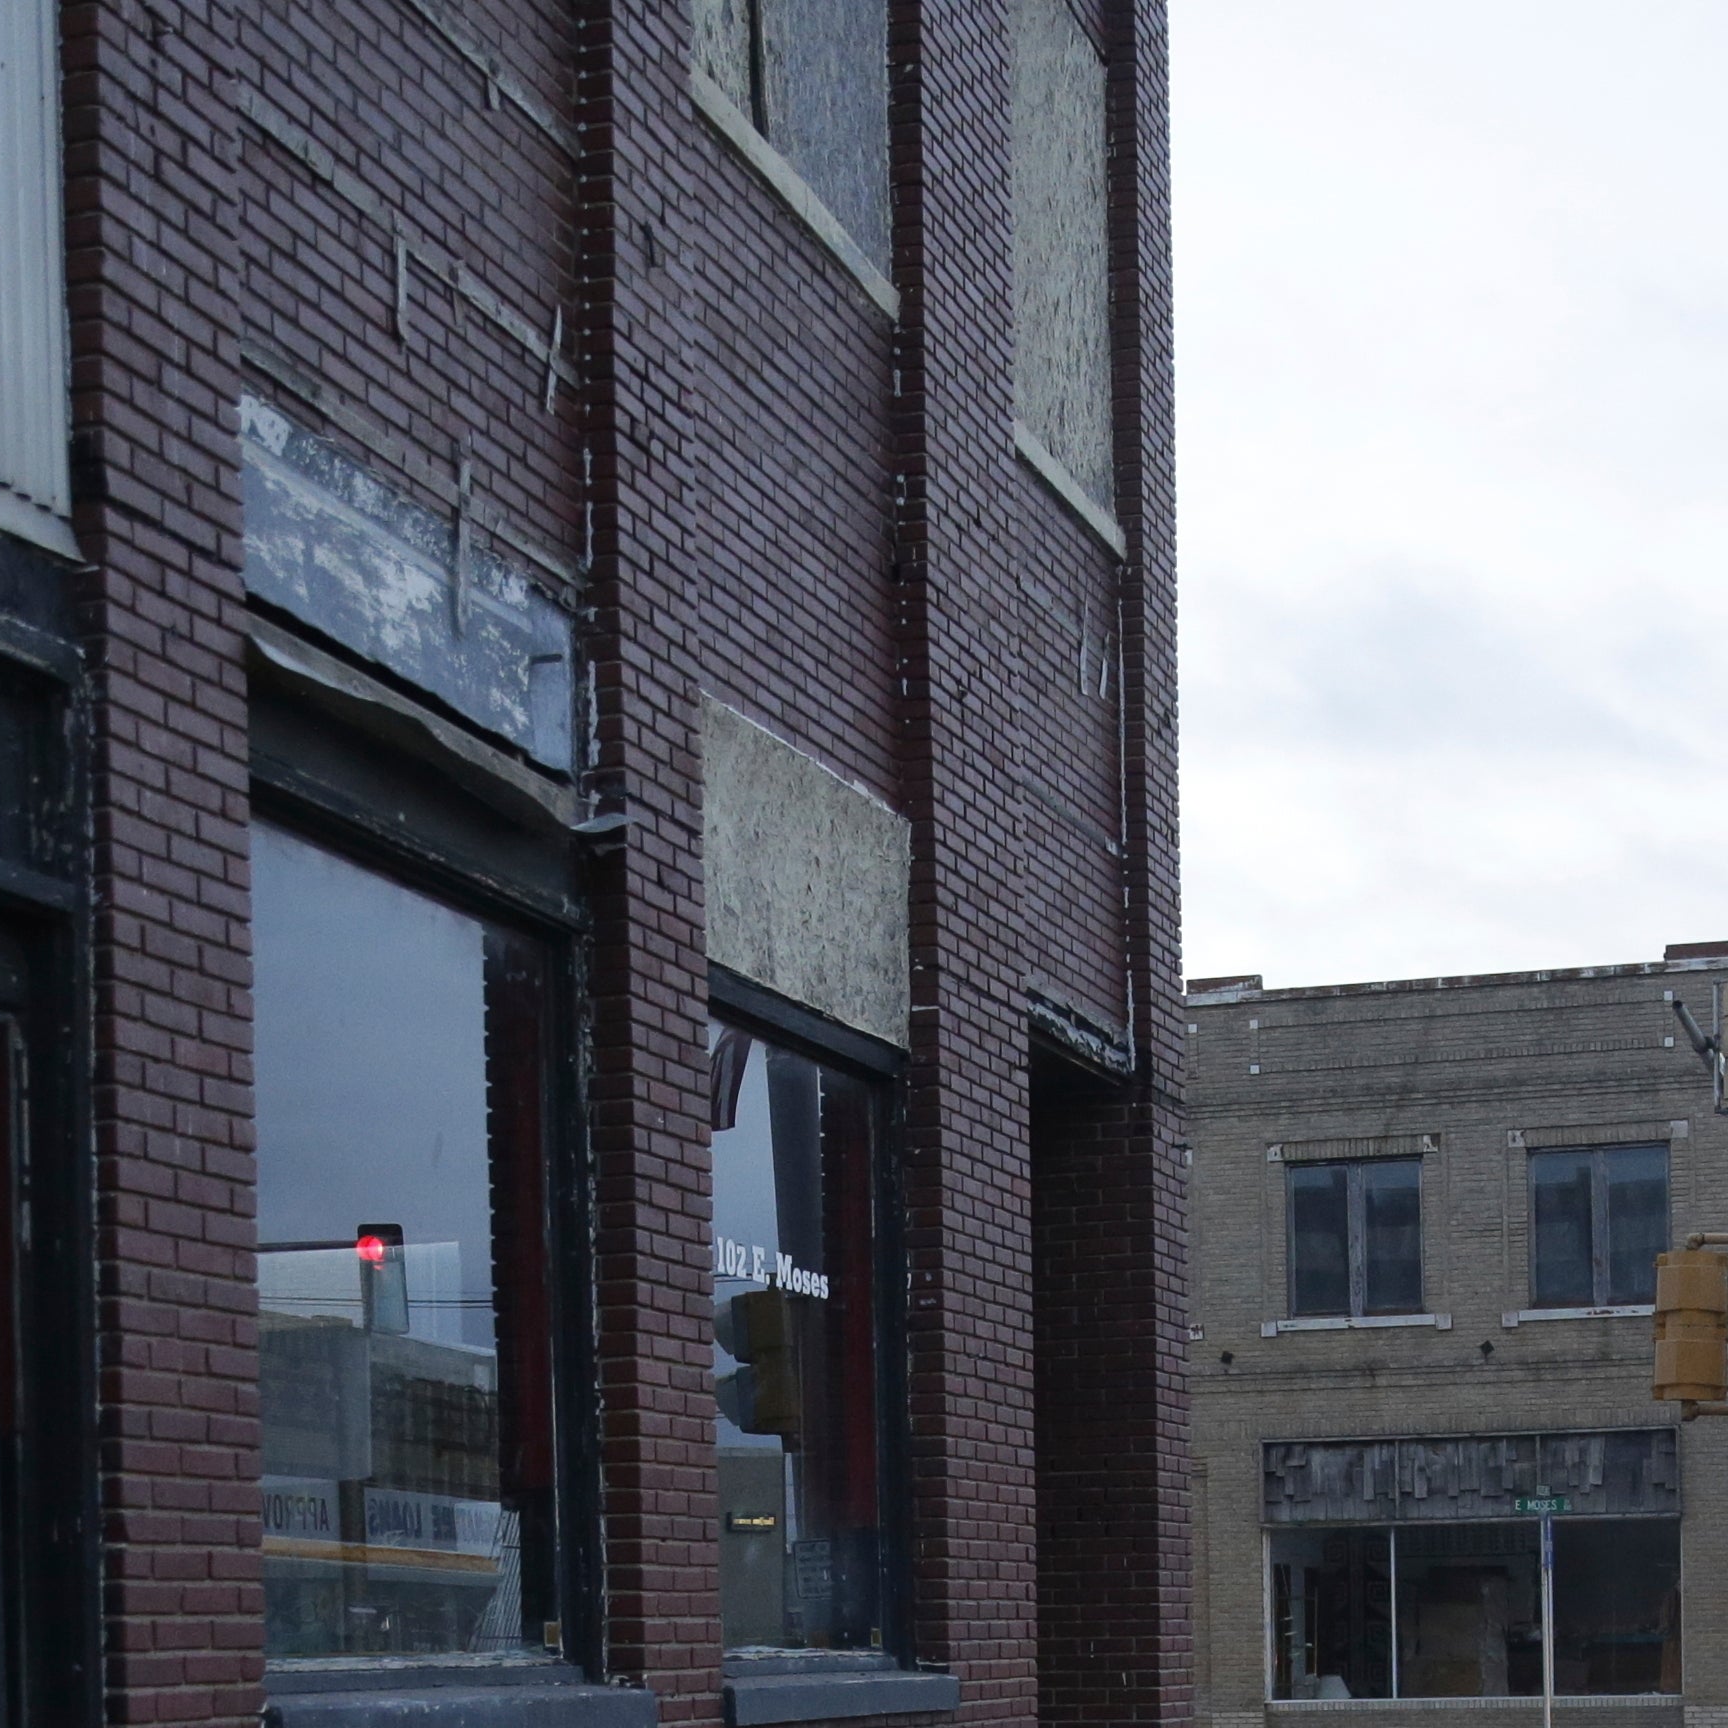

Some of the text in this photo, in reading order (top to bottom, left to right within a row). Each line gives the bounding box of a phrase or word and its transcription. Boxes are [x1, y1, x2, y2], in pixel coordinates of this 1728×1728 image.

[717, 1236, 830, 1300] 102 E. Moses
[1515, 1499, 1522, 1511] E
[1527, 1499, 1557, 1511] MOSES
